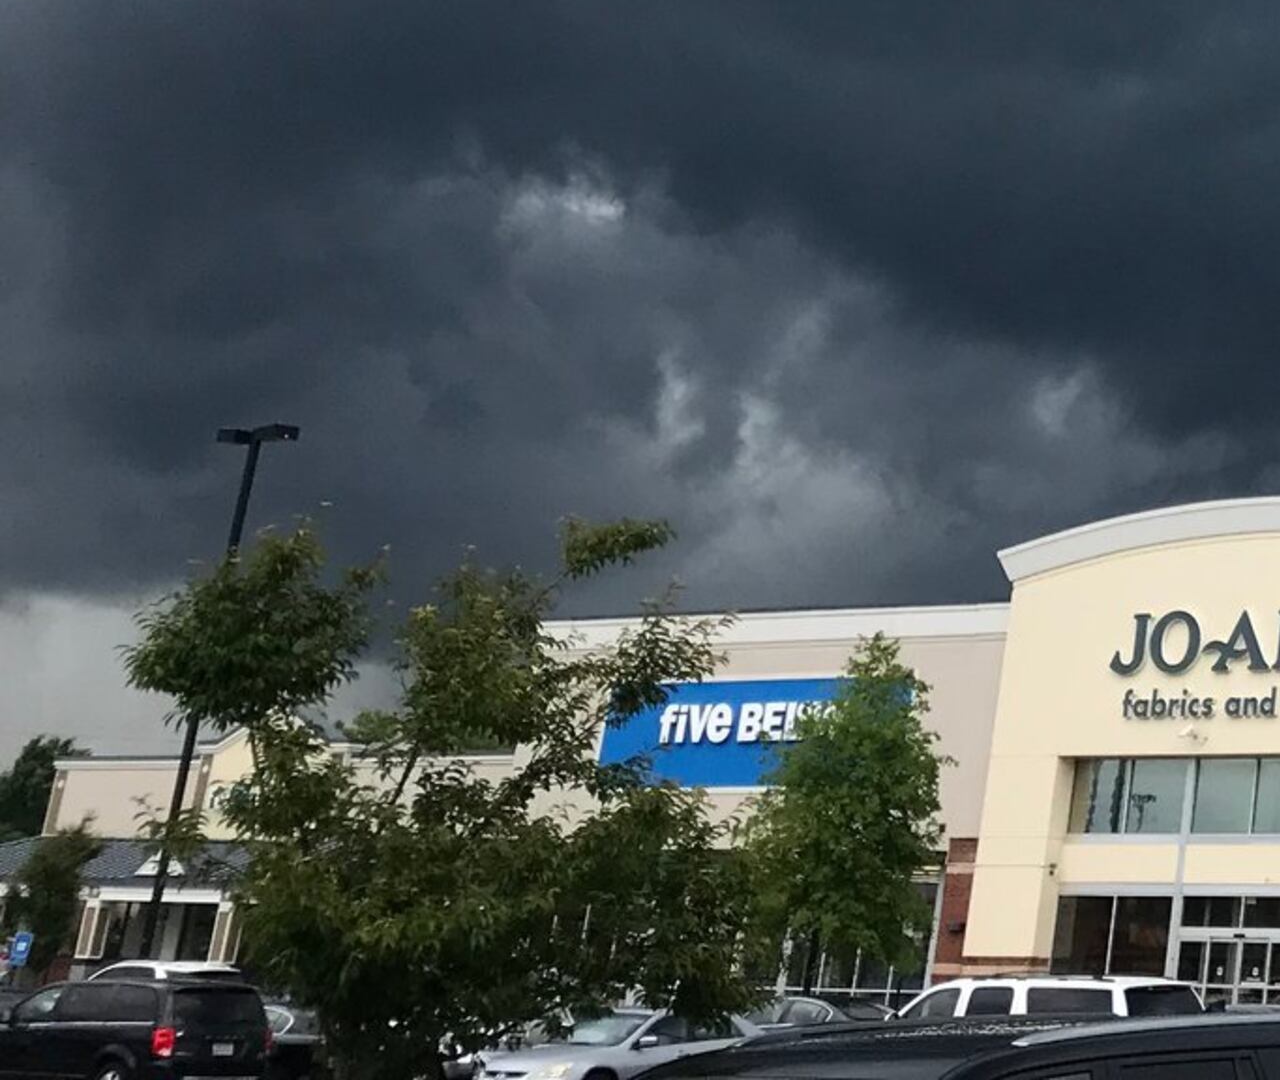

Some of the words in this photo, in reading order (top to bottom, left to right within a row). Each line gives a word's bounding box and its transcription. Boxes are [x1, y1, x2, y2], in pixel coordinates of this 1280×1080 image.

[1122, 688, 1214, 719] fabrics
[1224, 686, 1278, 717] and
[659, 701, 733, 745] five
[736, 700, 842, 743] BEL
